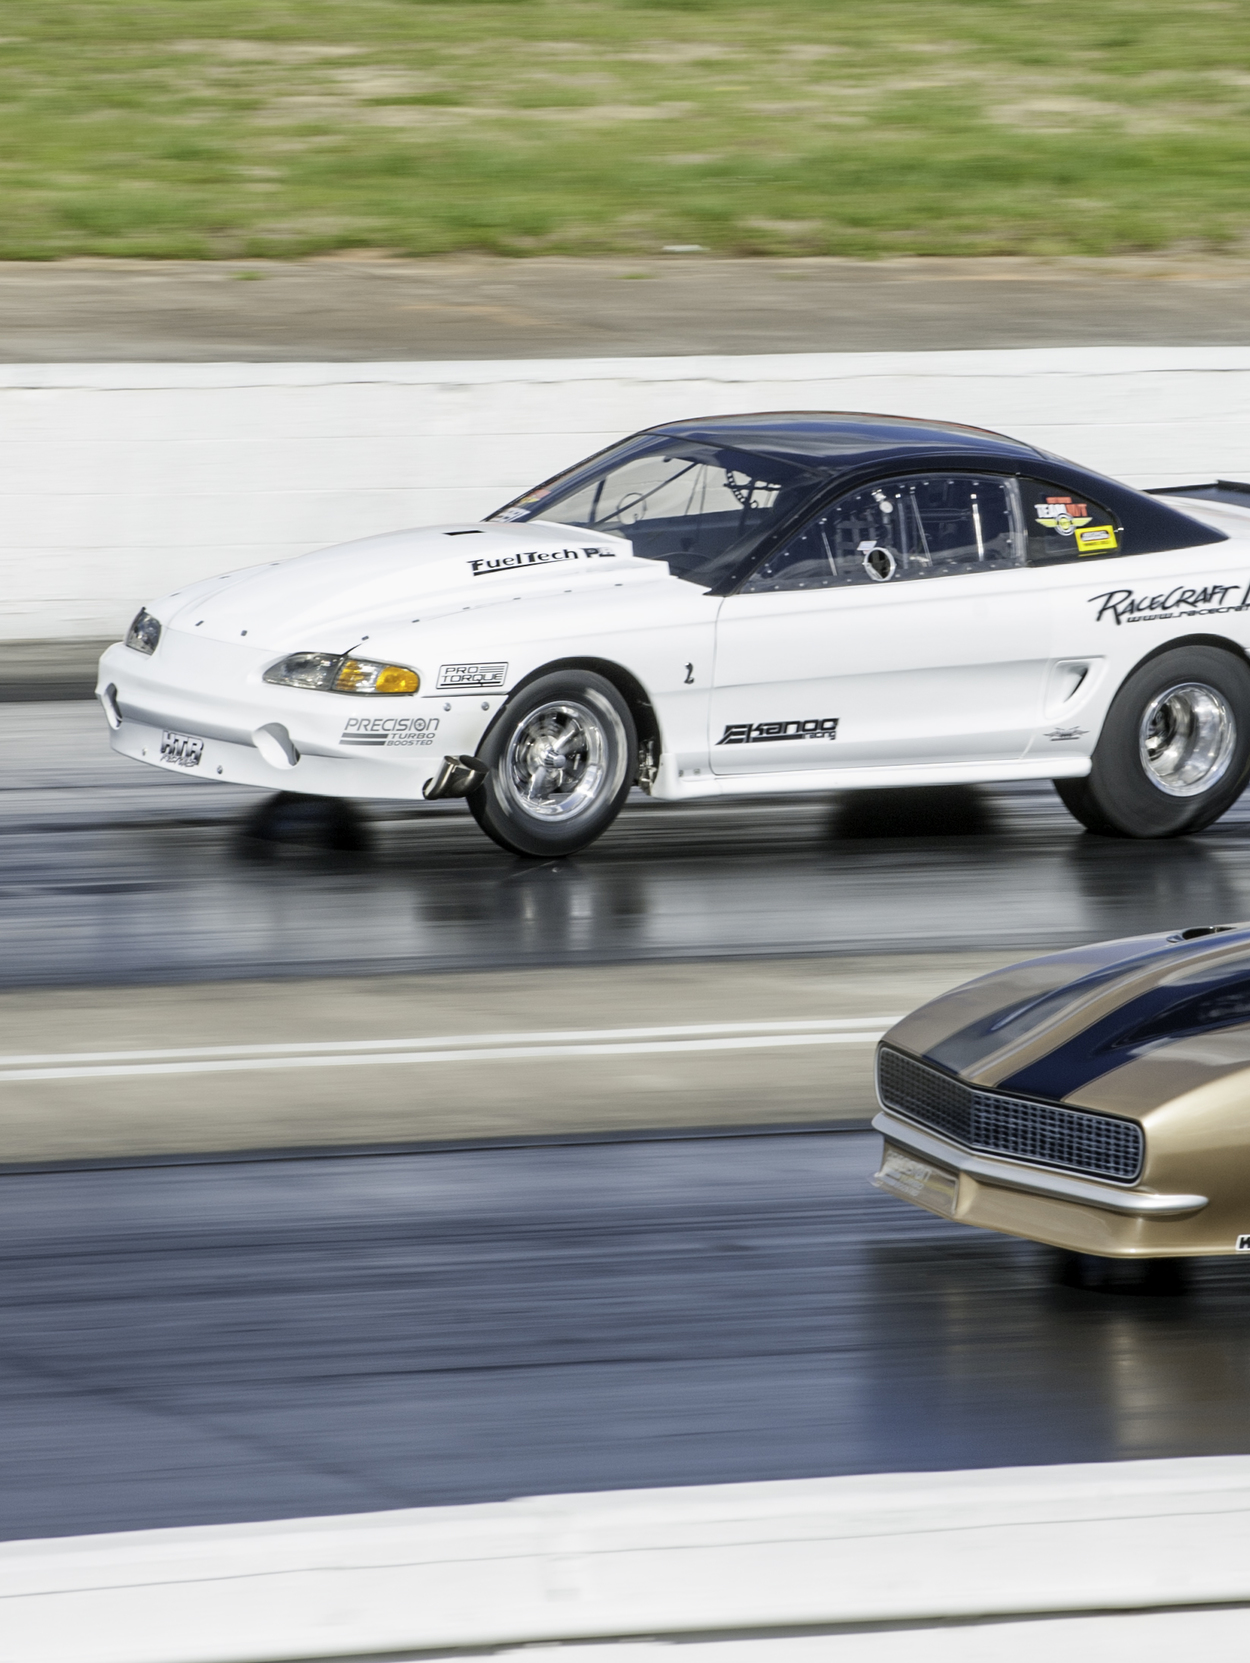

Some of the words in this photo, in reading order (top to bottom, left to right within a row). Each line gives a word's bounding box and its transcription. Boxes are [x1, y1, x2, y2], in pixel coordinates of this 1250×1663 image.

[467, 549, 579, 574] FuelTech
[444, 666, 479, 675] PRO
[441, 673, 503, 684] TORQUE
[391, 732, 436, 740] TURBO
[386, 739, 433, 747] BOOSTED
